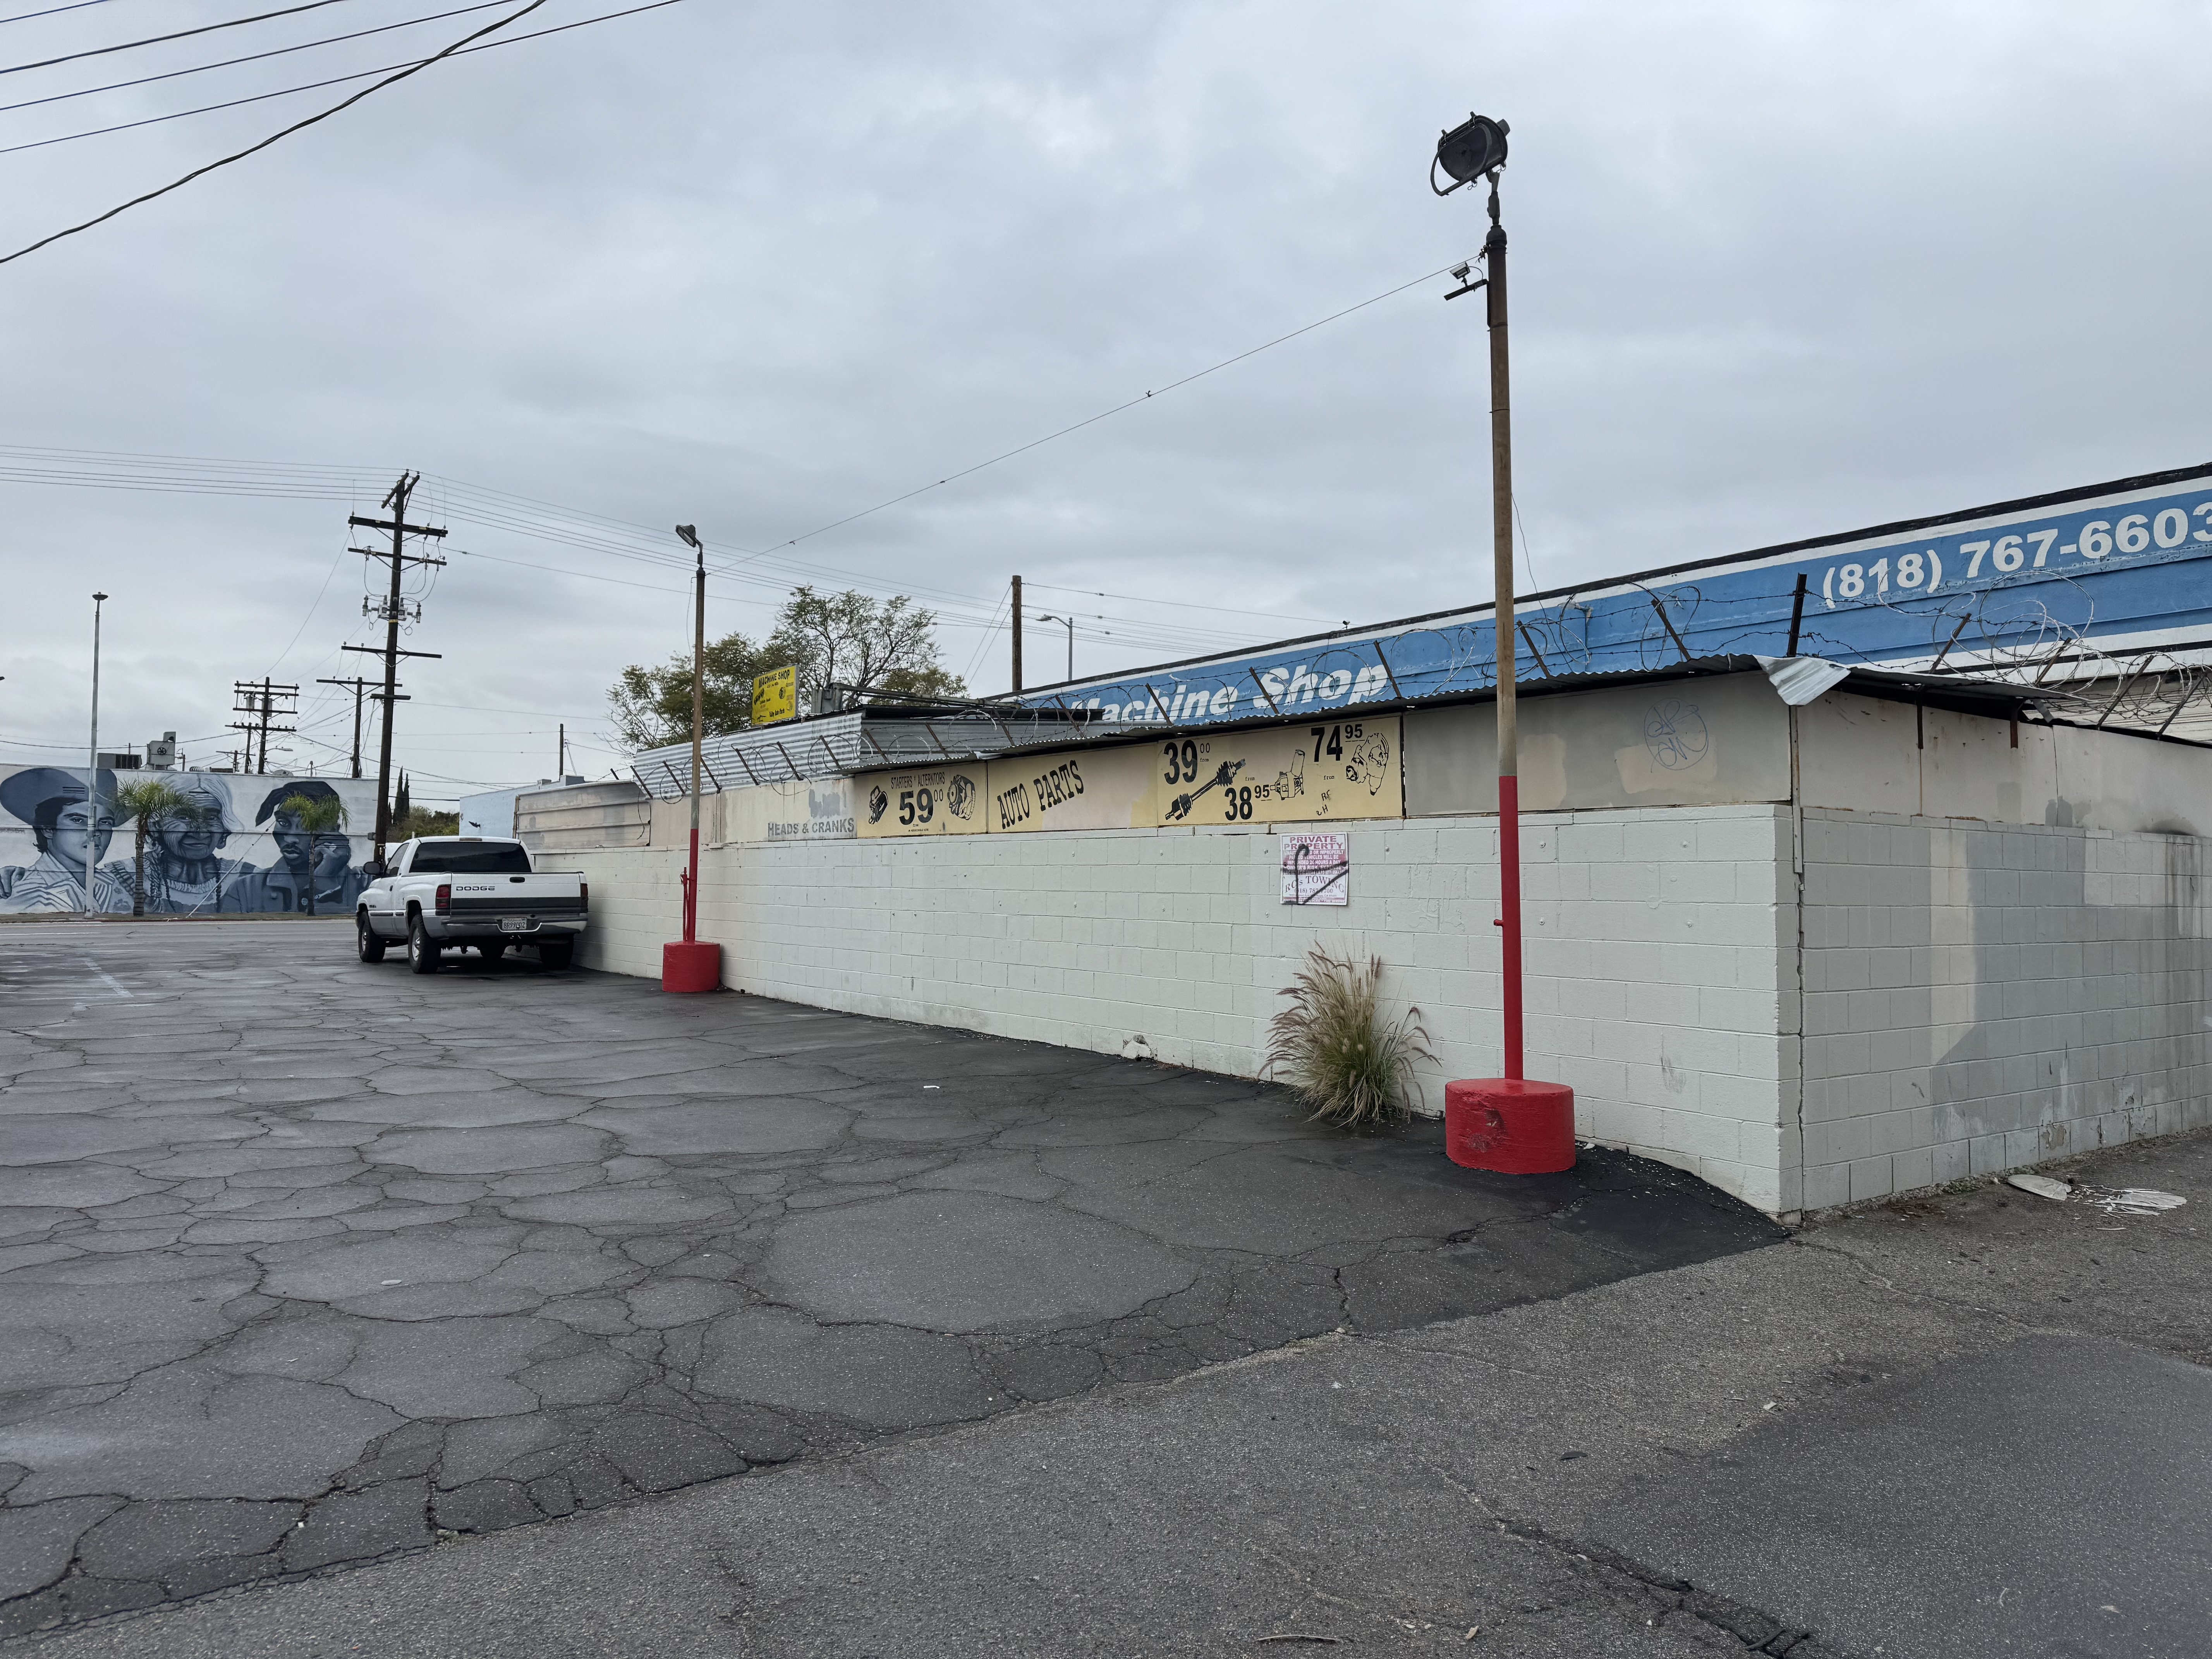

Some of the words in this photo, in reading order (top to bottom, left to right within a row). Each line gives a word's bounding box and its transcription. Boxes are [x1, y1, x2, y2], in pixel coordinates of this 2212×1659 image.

[1823, 550, 1942, 608] (818)
[1960, 502, 2212, 579] 767-6603
[759, 673, 777, 689] MACHINE
[778, 669, 790, 680] SHOP
[1253, 664, 1388, 709] Shop
[1311, 725, 1343, 762] 74
[1345, 724, 1363, 739] 95
[1164, 740, 1198, 785] 39
[891, 776, 912, 789] STARTERS
[997, 783, 1030, 830] AUTO
[1033, 759, 1084, 812] PARTS
[899, 788, 933, 825] 59
[1224, 786, 1253, 821] 38
[1254, 785, 1270, 799] 95
[768, 823, 799, 837] HEADS
[802, 823, 809, 833] &
[812, 817, 854, 833] CRANKS
